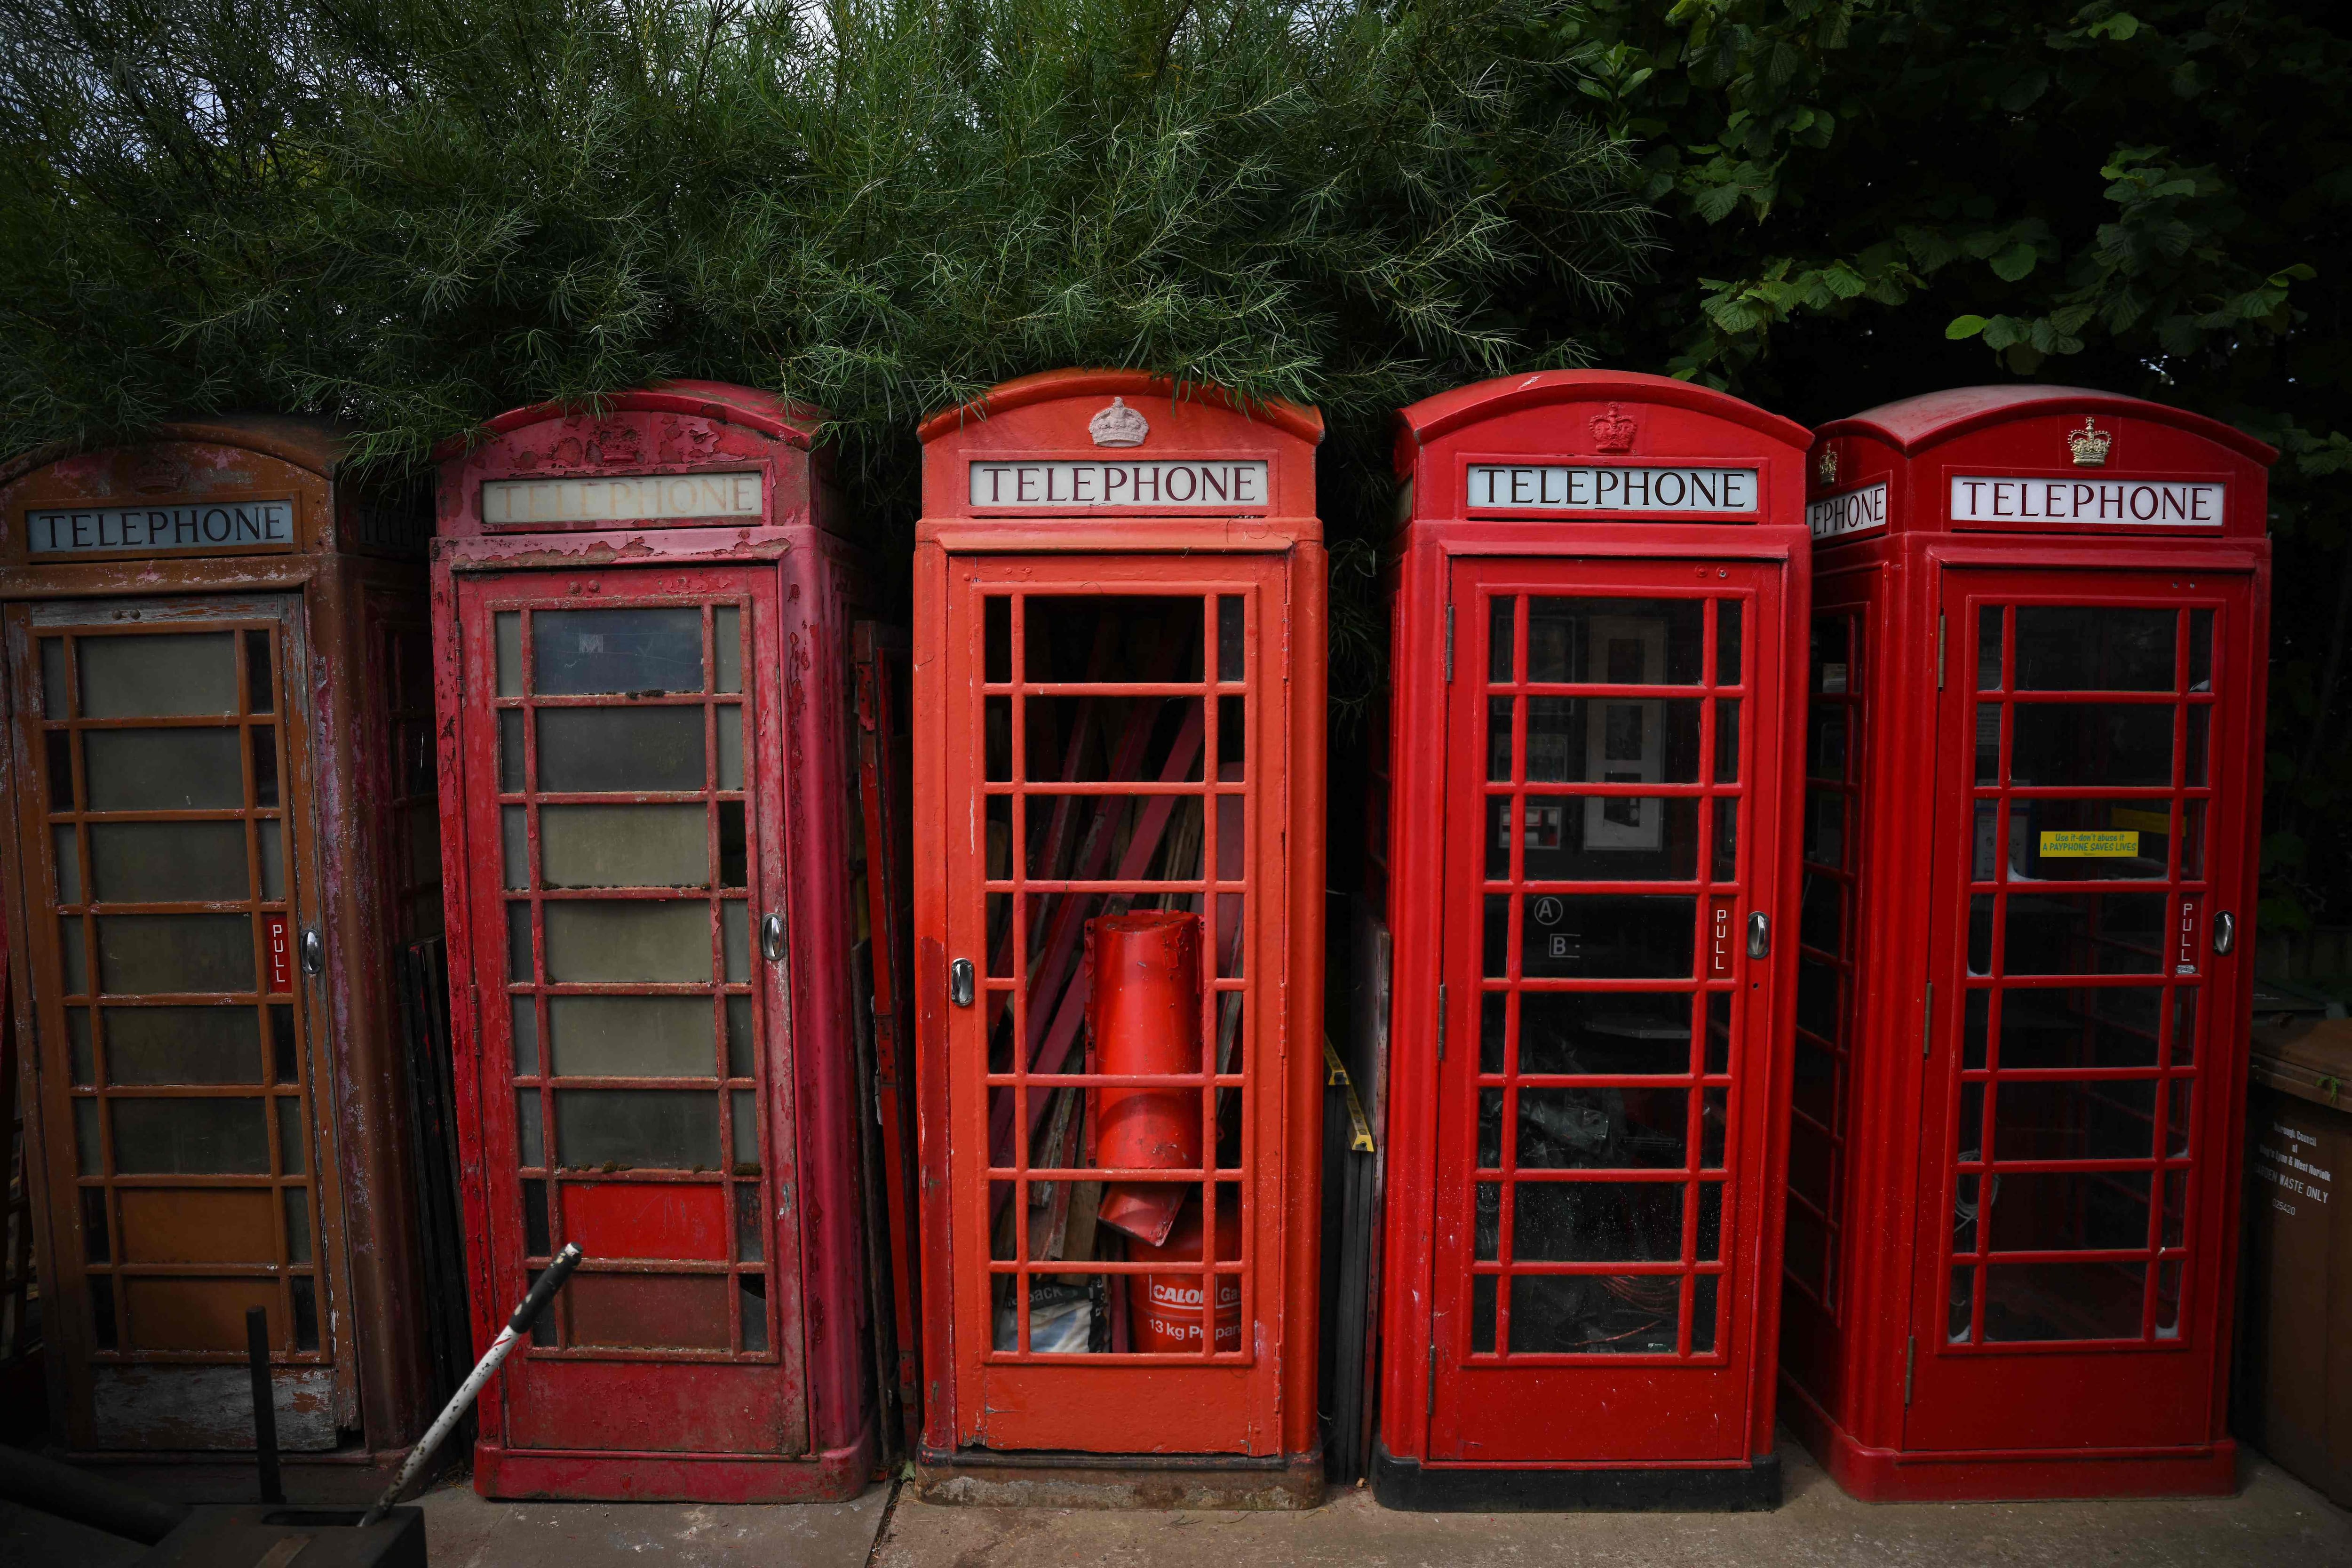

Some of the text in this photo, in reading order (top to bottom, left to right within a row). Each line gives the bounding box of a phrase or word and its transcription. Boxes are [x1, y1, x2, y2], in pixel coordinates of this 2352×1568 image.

[497, 477, 754, 518] TELEPHONE
[982, 467, 1255, 502] TELEPHONE
[1478, 469, 1745, 507] TELEPHONE
[1962, 482, 2213, 521] TELEPHONE
[39, 506, 285, 548] TELEPHONE
[1806, 488, 1884, 535] EPHONE
[1538, 899, 1552, 918] A
[1553, 936, 1565, 955] B
[1715, 910, 1727, 970] PULL
[2181, 903, 2193, 962] PULL
[273, 924, 286, 982] PULL
[2292, 1144, 2298, 1153] of
[2296, 1130, 2317, 1146] Council
[2288, 1156, 2293, 1166] &
[2294, 1158, 2309, 1172] West
[2309, 1164, 2331, 1182] Norfolk
[2279, 1173, 2304, 1194] WASTE
[2306, 1186, 2328, 1203] ONLY
[1220, 1287, 1240, 1302] Ga
[1149, 1319, 1241, 1341] 13 kg Prpan
